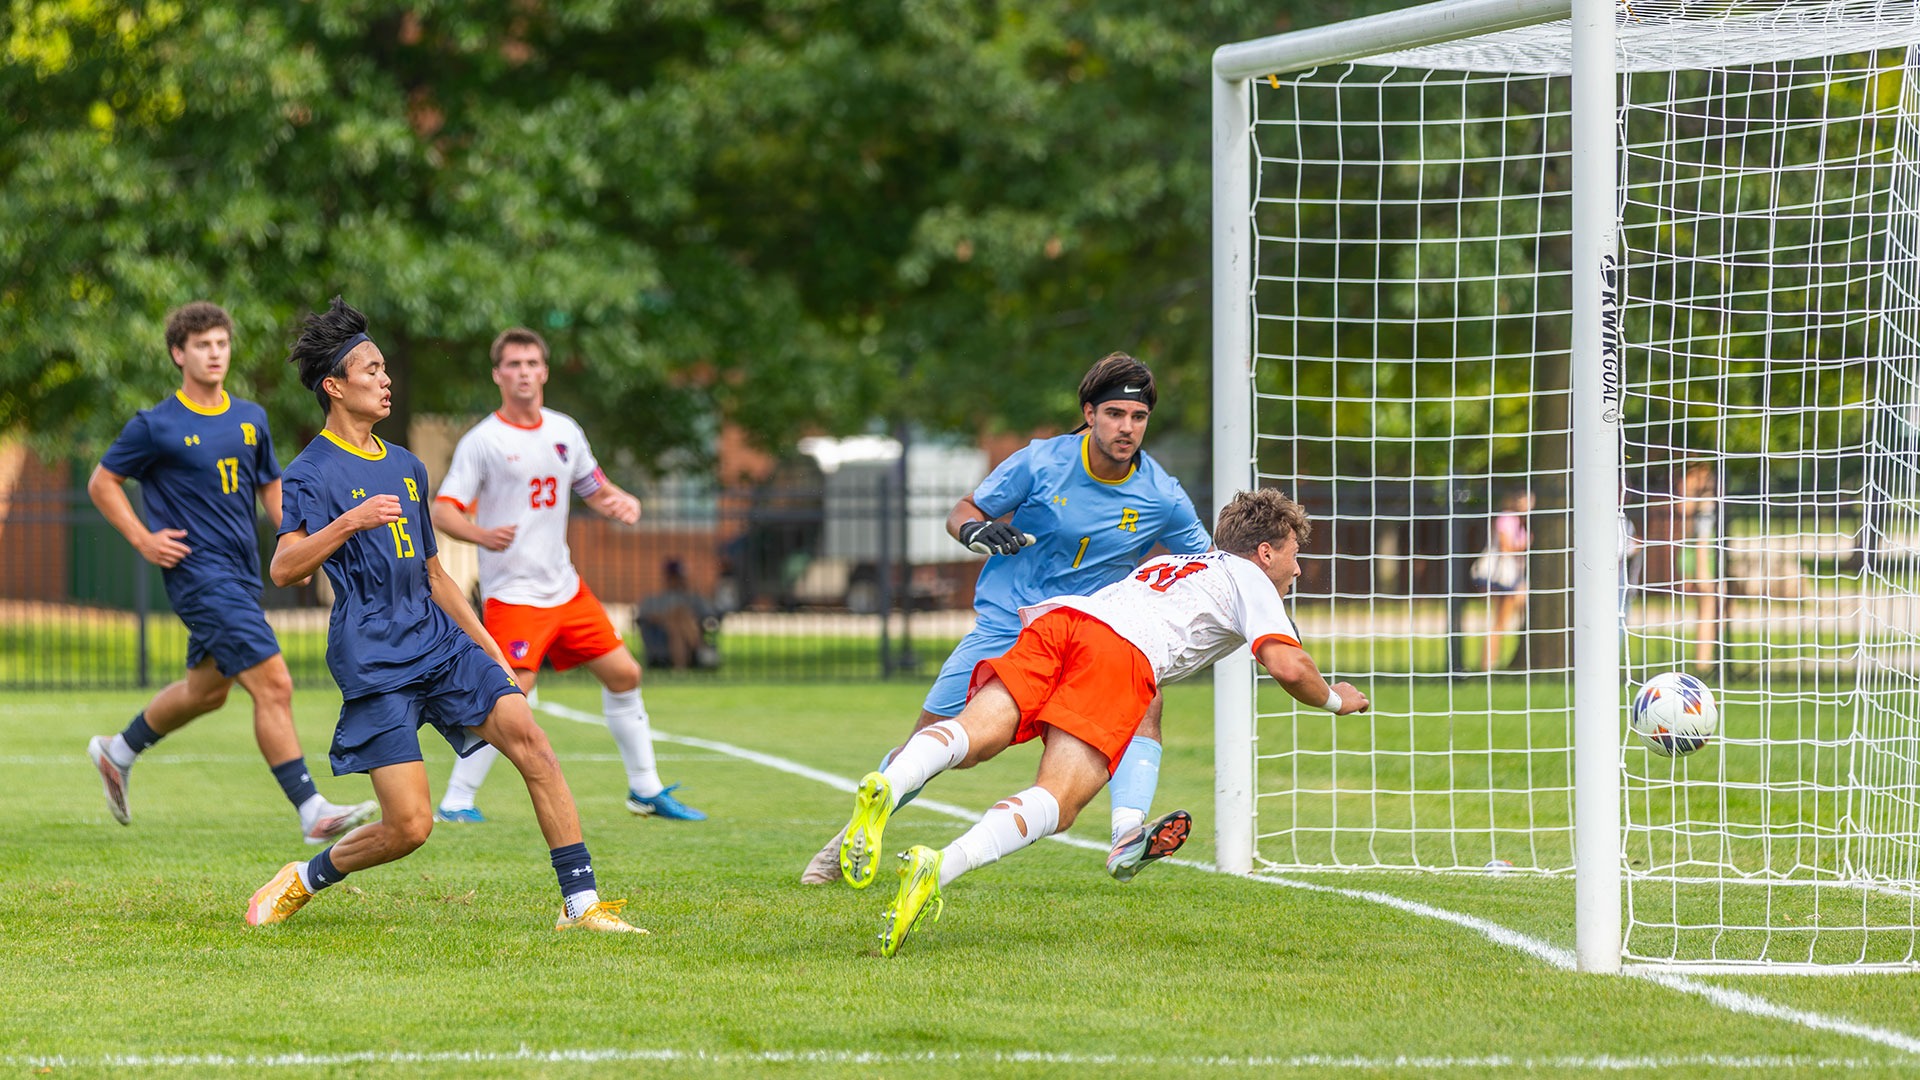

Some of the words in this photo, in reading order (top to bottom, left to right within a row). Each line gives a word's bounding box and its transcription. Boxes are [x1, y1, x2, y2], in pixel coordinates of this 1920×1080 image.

[240, 422, 257, 446] R
[216, 456, 239, 495] 17
[403, 477, 420, 502] R
[530, 476, 557, 509] 23
[1117, 507, 1139, 533] R
[387, 517, 415, 558] 15
[1072, 536, 1091, 569] 1
